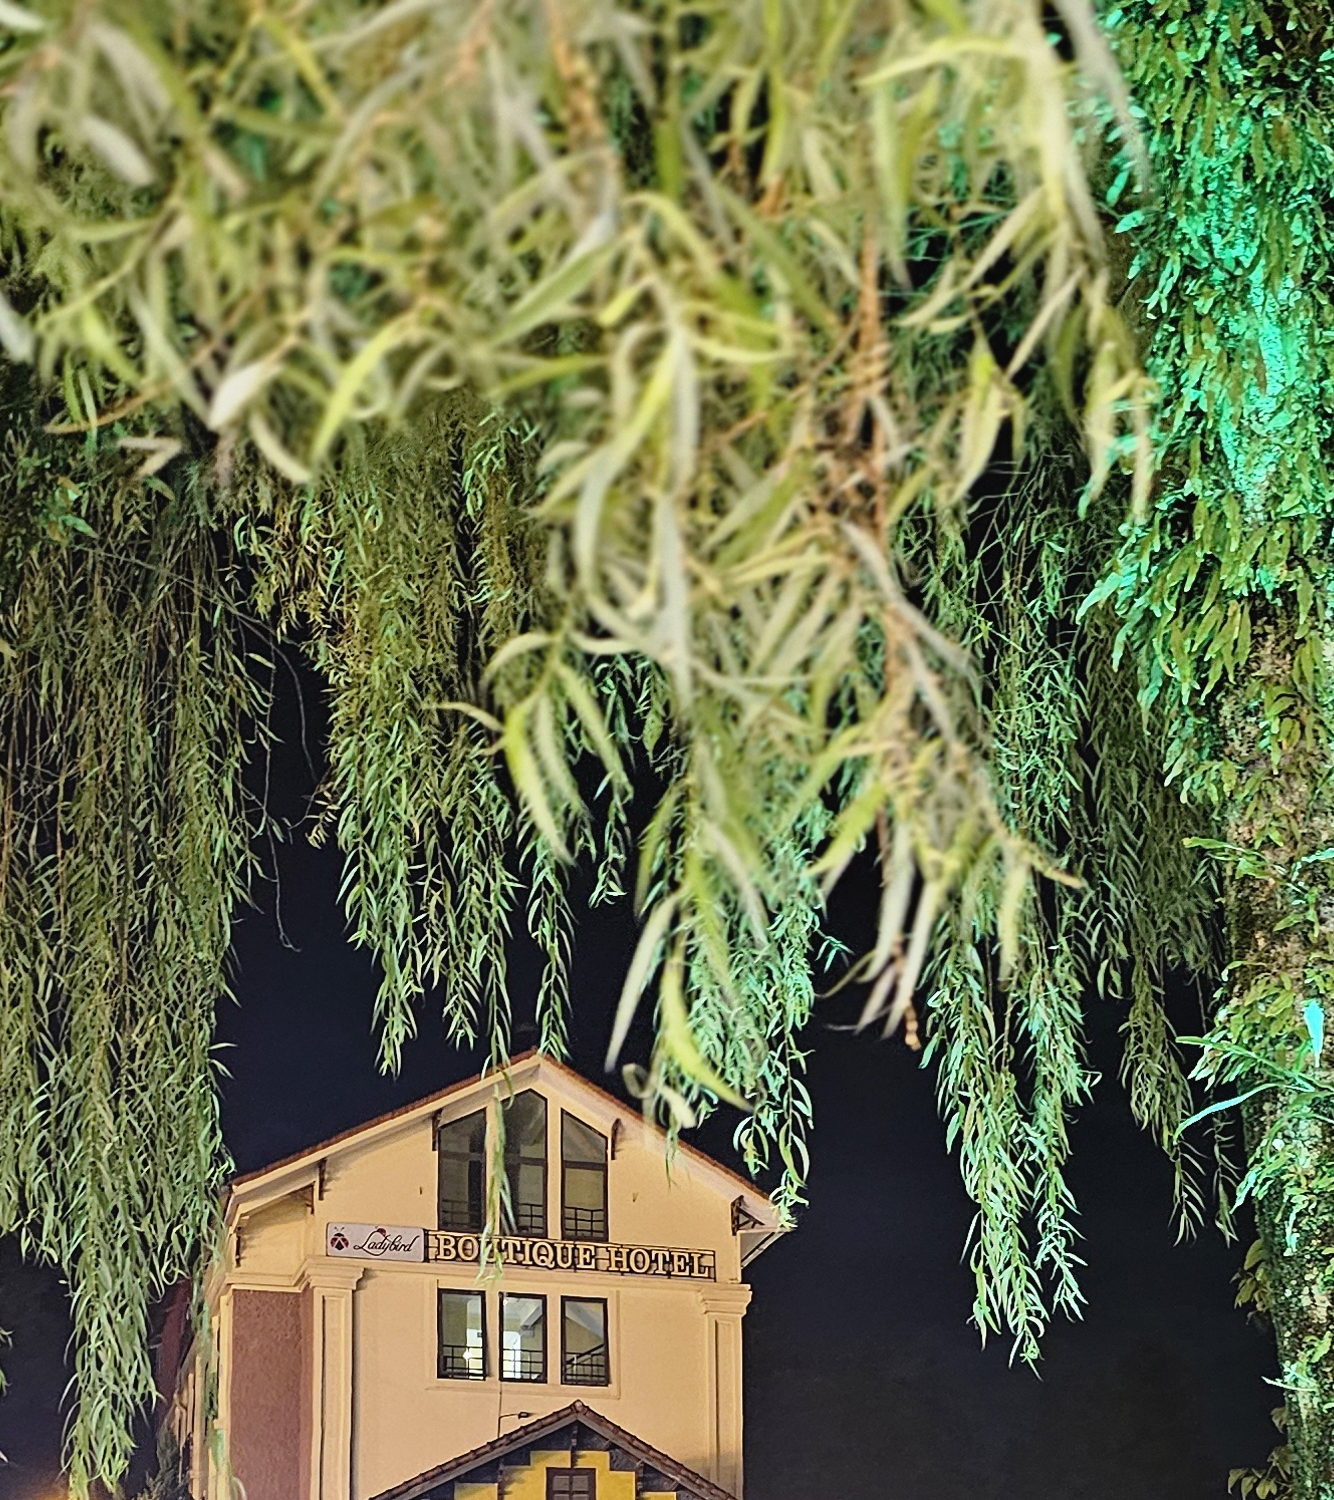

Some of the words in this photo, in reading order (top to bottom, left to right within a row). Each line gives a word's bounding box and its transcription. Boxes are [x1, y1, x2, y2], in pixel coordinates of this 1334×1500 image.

[354, 1230, 420, 1256] Ladybird
[437, 1235, 596, 1269] BOUTIQUE
[608, 1247, 709, 1278] HOTEL
